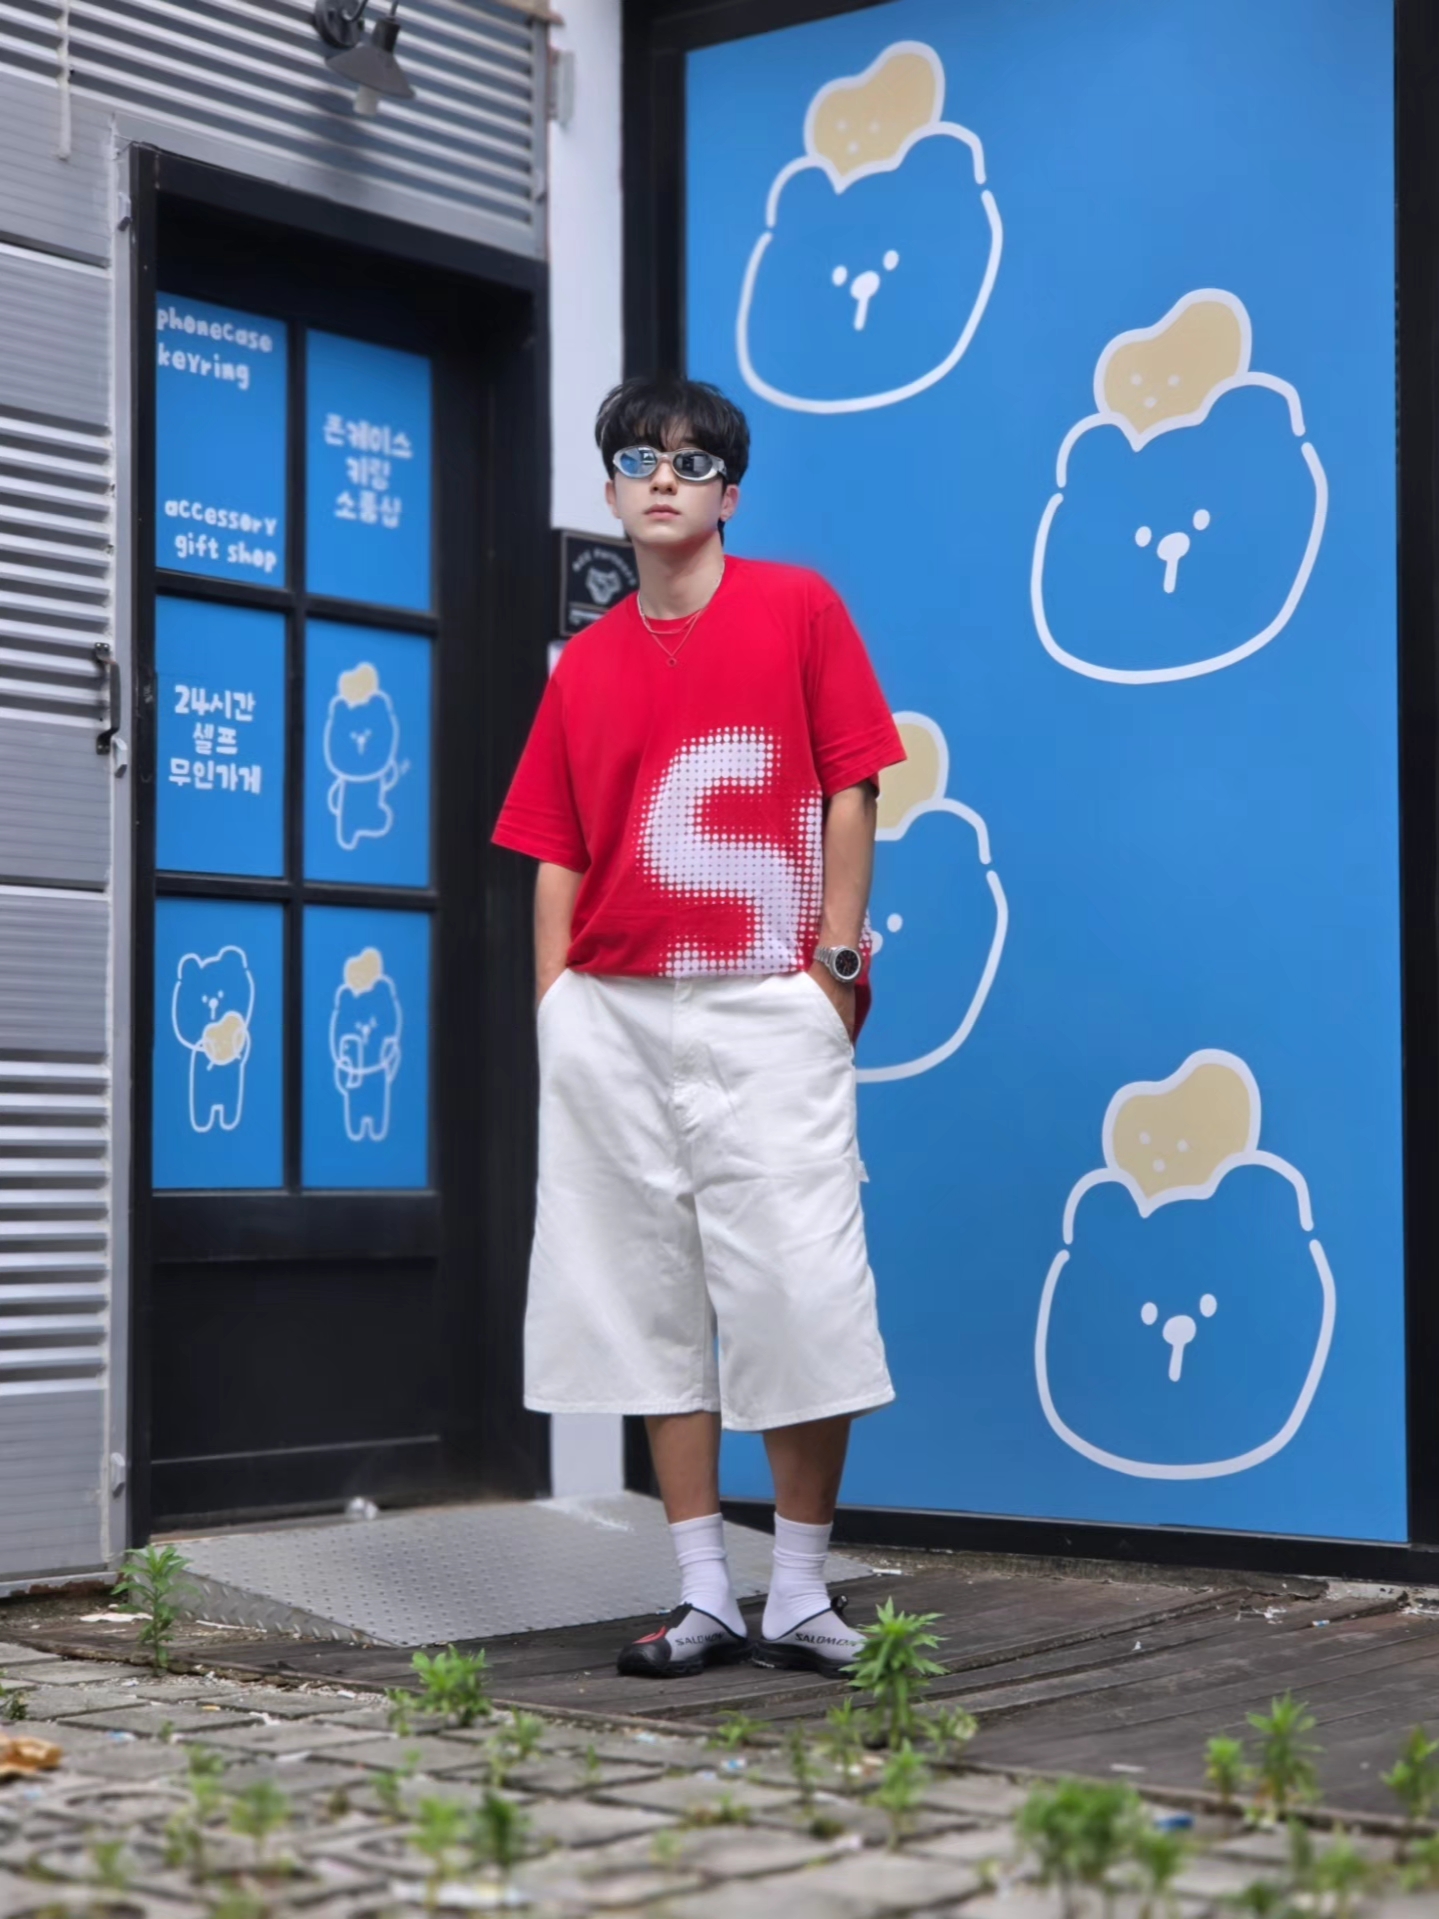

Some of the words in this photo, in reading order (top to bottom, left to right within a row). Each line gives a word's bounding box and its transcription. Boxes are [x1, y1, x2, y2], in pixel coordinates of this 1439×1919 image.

[345, 456, 391, 491] 키링
[175, 531, 219, 559] gift
[227, 540, 277, 573] shop
[174, 684, 256, 722] 24시간
[193, 721, 238, 755] 셀프
[168, 757, 262, 795] 무인가게
